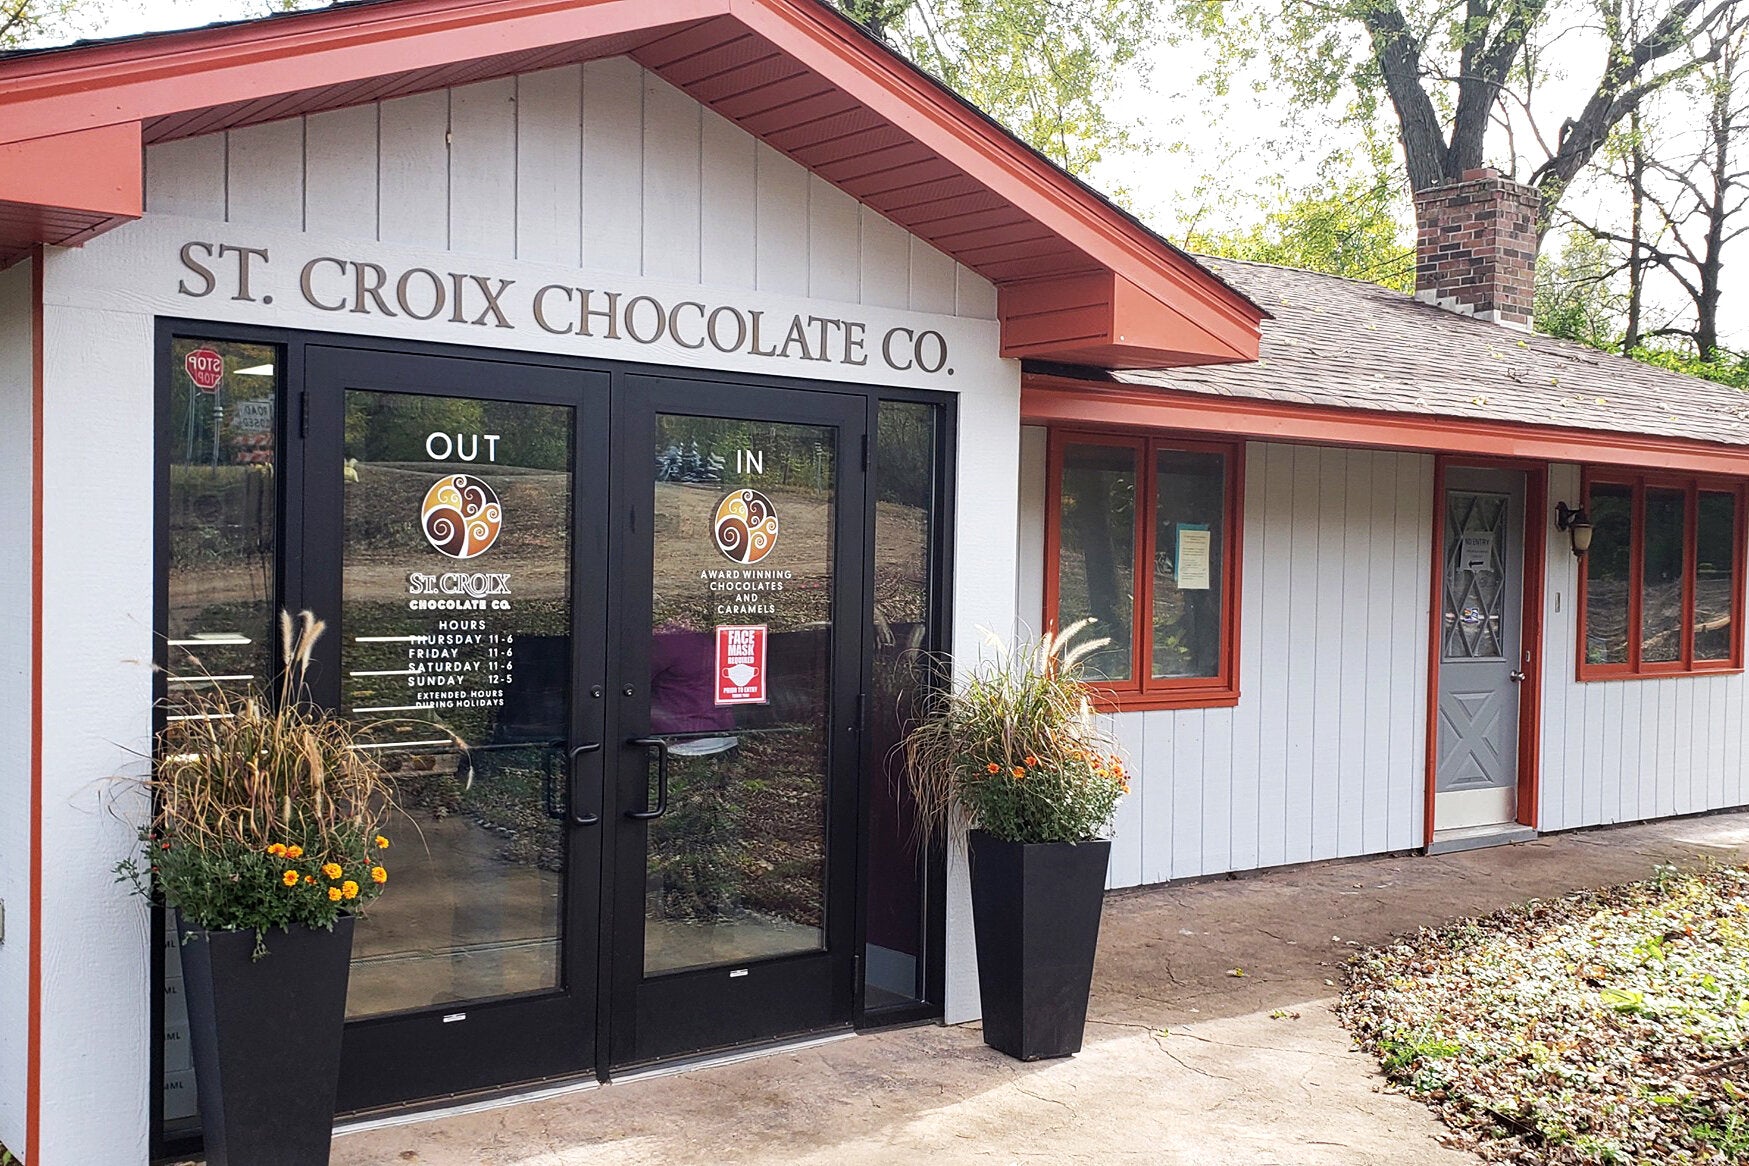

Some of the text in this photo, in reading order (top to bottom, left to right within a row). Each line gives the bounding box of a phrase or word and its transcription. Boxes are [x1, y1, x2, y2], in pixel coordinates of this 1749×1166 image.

[178, 241, 956, 376] ST. CROIX CHOCOLATE CO.
[425, 431, 500, 462] OUT
[737, 449, 763, 474] IN
[700, 570, 792, 579] AWARD WINNING
[409, 572, 512, 598] ST. CROIX
[709, 582, 784, 591] CHOCOLATES
[735, 593, 759, 602] AND
[409, 599, 487, 610] CHOCOLATE
[717, 604, 776, 614] CARAMELS
[439, 620, 487, 630] HOURS
[409, 634, 482, 645] THURSDAY
[728, 630, 755, 645] FACE
[408, 648, 459, 659] FRIDAY
[728, 644, 755, 656] MASK
[408, 661, 481, 672] SATURDAY
[407, 675, 464, 687] SUNDAY
[417, 690, 504, 700] EXTENDED HOURS
[415, 698, 504, 708] DURING HOLIDAYS
